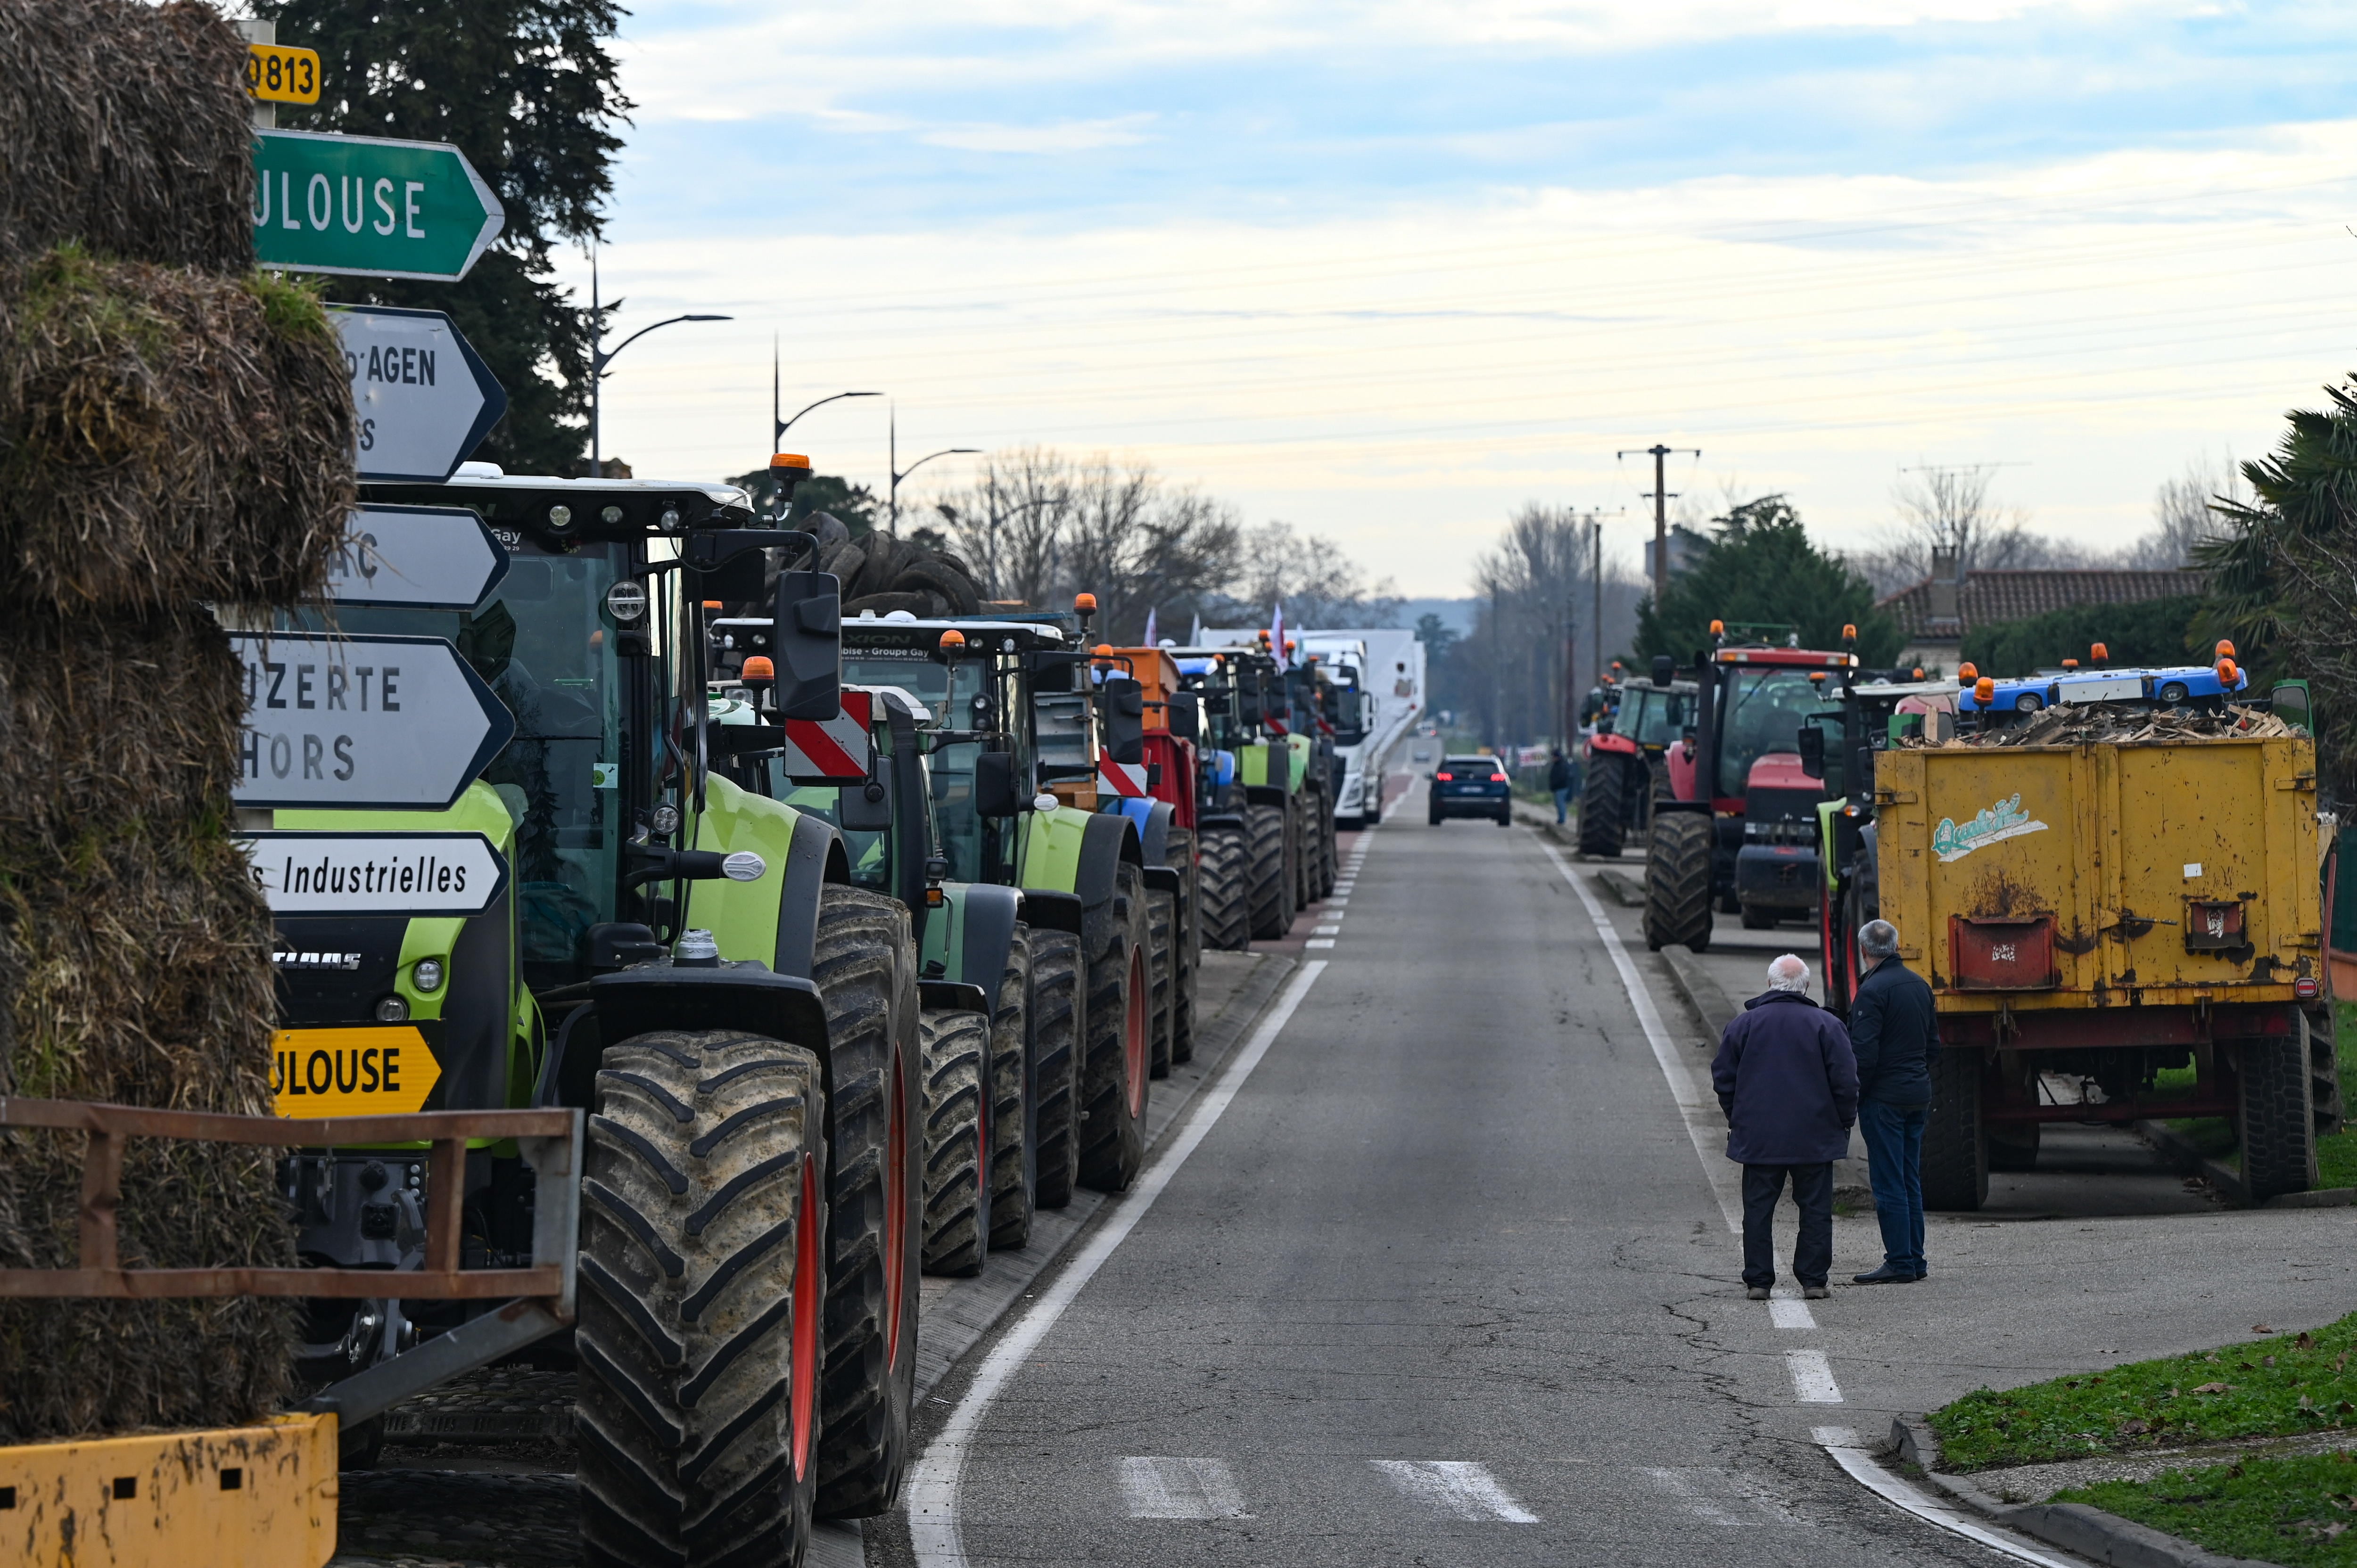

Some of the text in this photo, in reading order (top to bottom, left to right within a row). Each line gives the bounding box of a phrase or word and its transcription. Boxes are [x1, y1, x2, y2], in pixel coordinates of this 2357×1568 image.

[872, 648, 907, 657] Groupe
[910, 649, 929, 657] Gay
[283, 856, 466, 894] Industrielles
[272, 952, 362, 970] CLAAS
